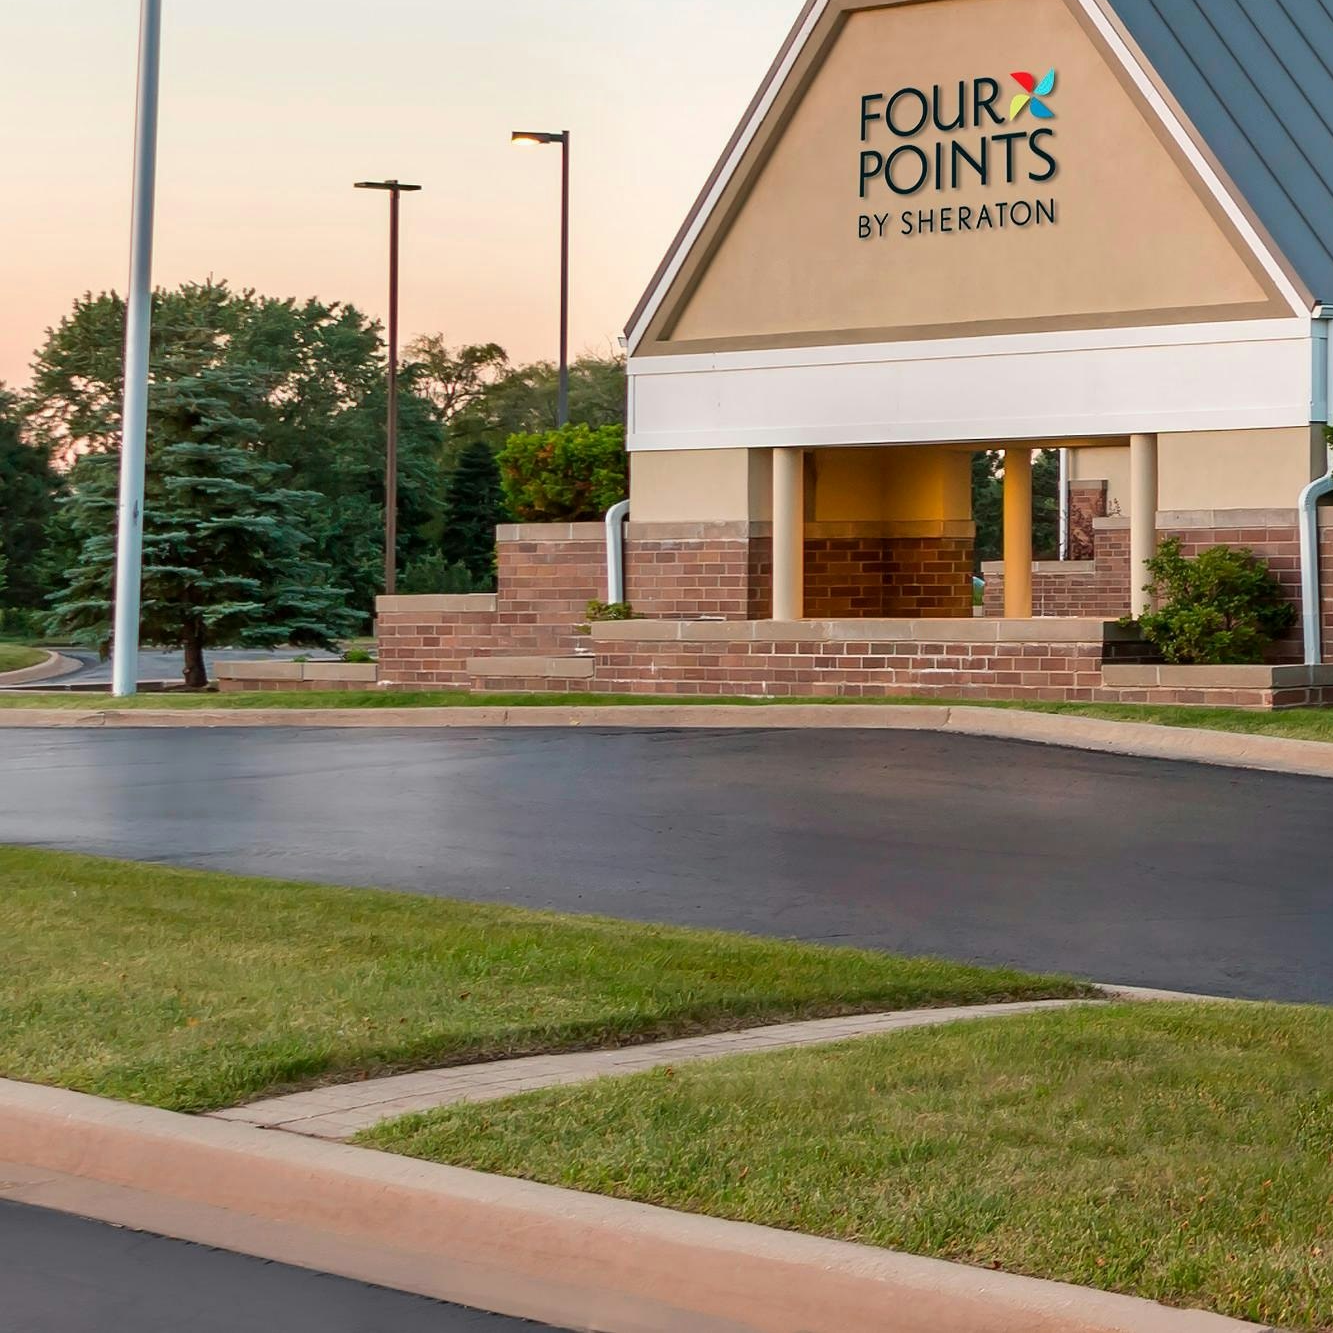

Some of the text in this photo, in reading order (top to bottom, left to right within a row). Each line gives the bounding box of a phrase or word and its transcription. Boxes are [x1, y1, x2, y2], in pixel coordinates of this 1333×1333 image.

[860, 77, 1006, 141] FOUR
[859, 128, 1057, 198] POINTS
[858, 198, 1056, 239] BY SHERATON
